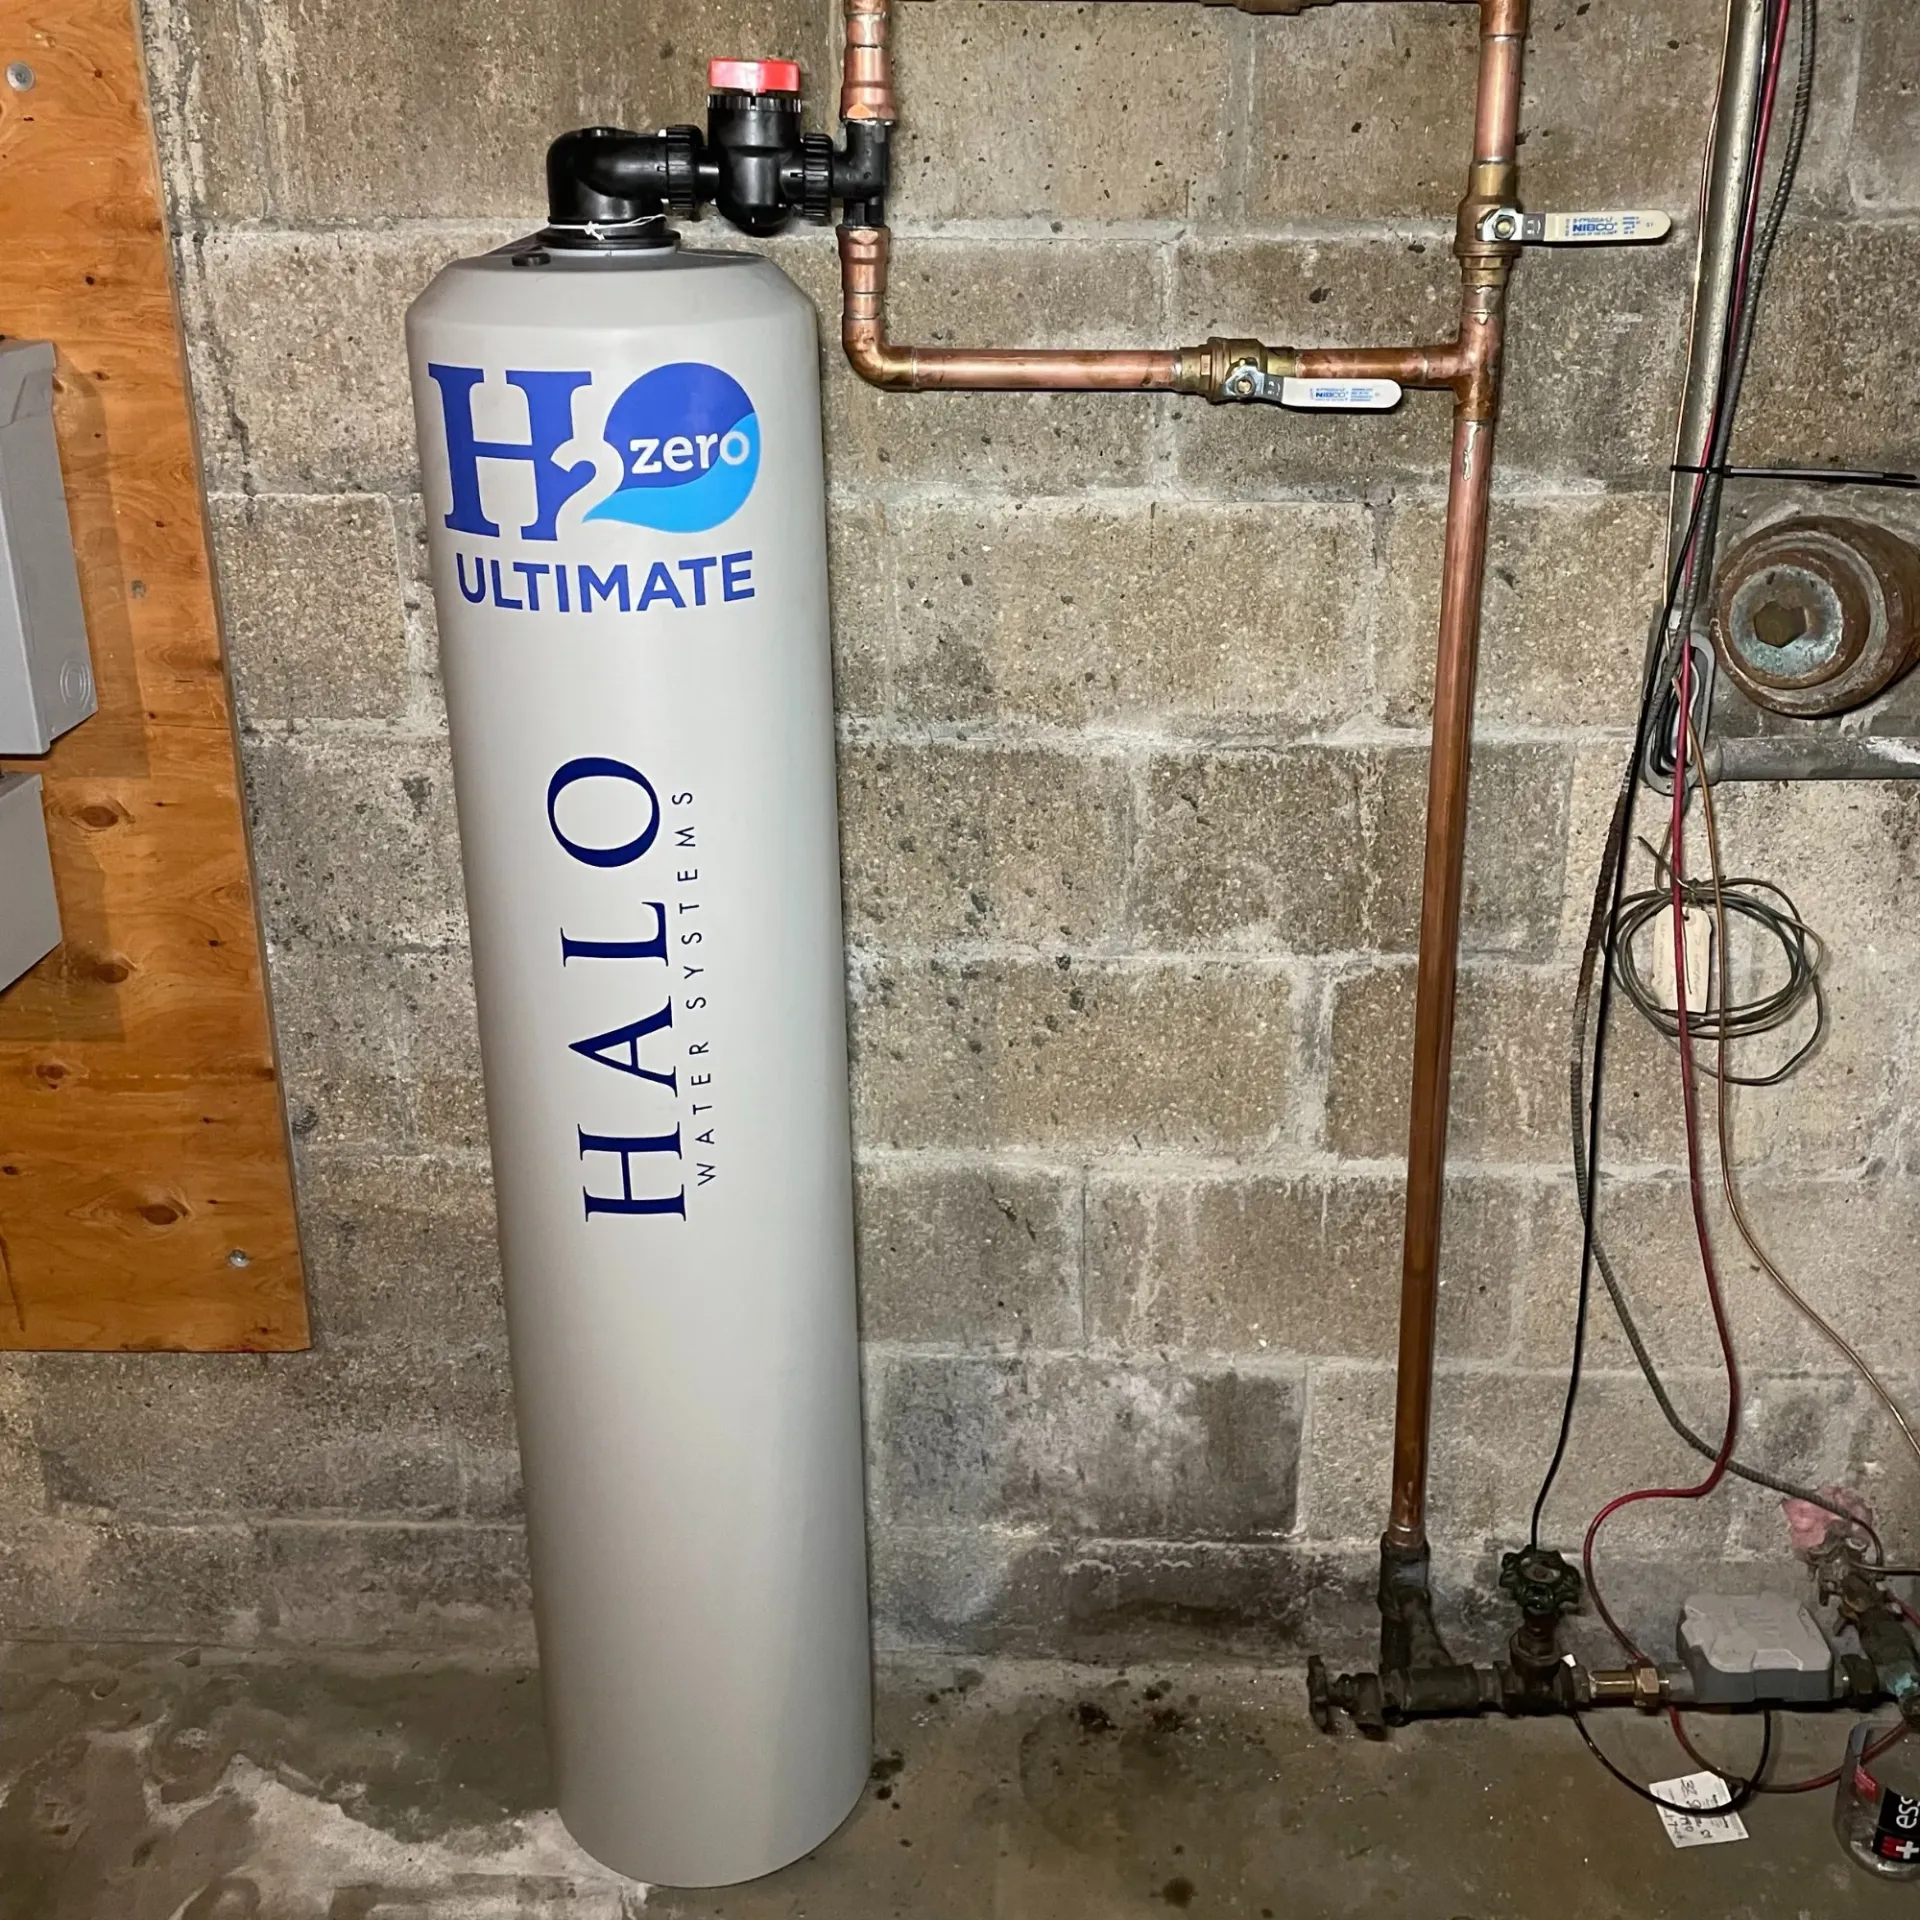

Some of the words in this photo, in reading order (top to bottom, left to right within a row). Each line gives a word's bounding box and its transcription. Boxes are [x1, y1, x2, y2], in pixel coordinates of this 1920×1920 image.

[1573, 223, 1614, 232] NIBCO
[629, 430, 749, 474] zero
[456, 550, 755, 613] ULTIMATE
[671, 791, 706, 1010] SYSTEMS
[547, 756, 686, 1222] HALO
[689, 1040, 716, 1186] WATER
